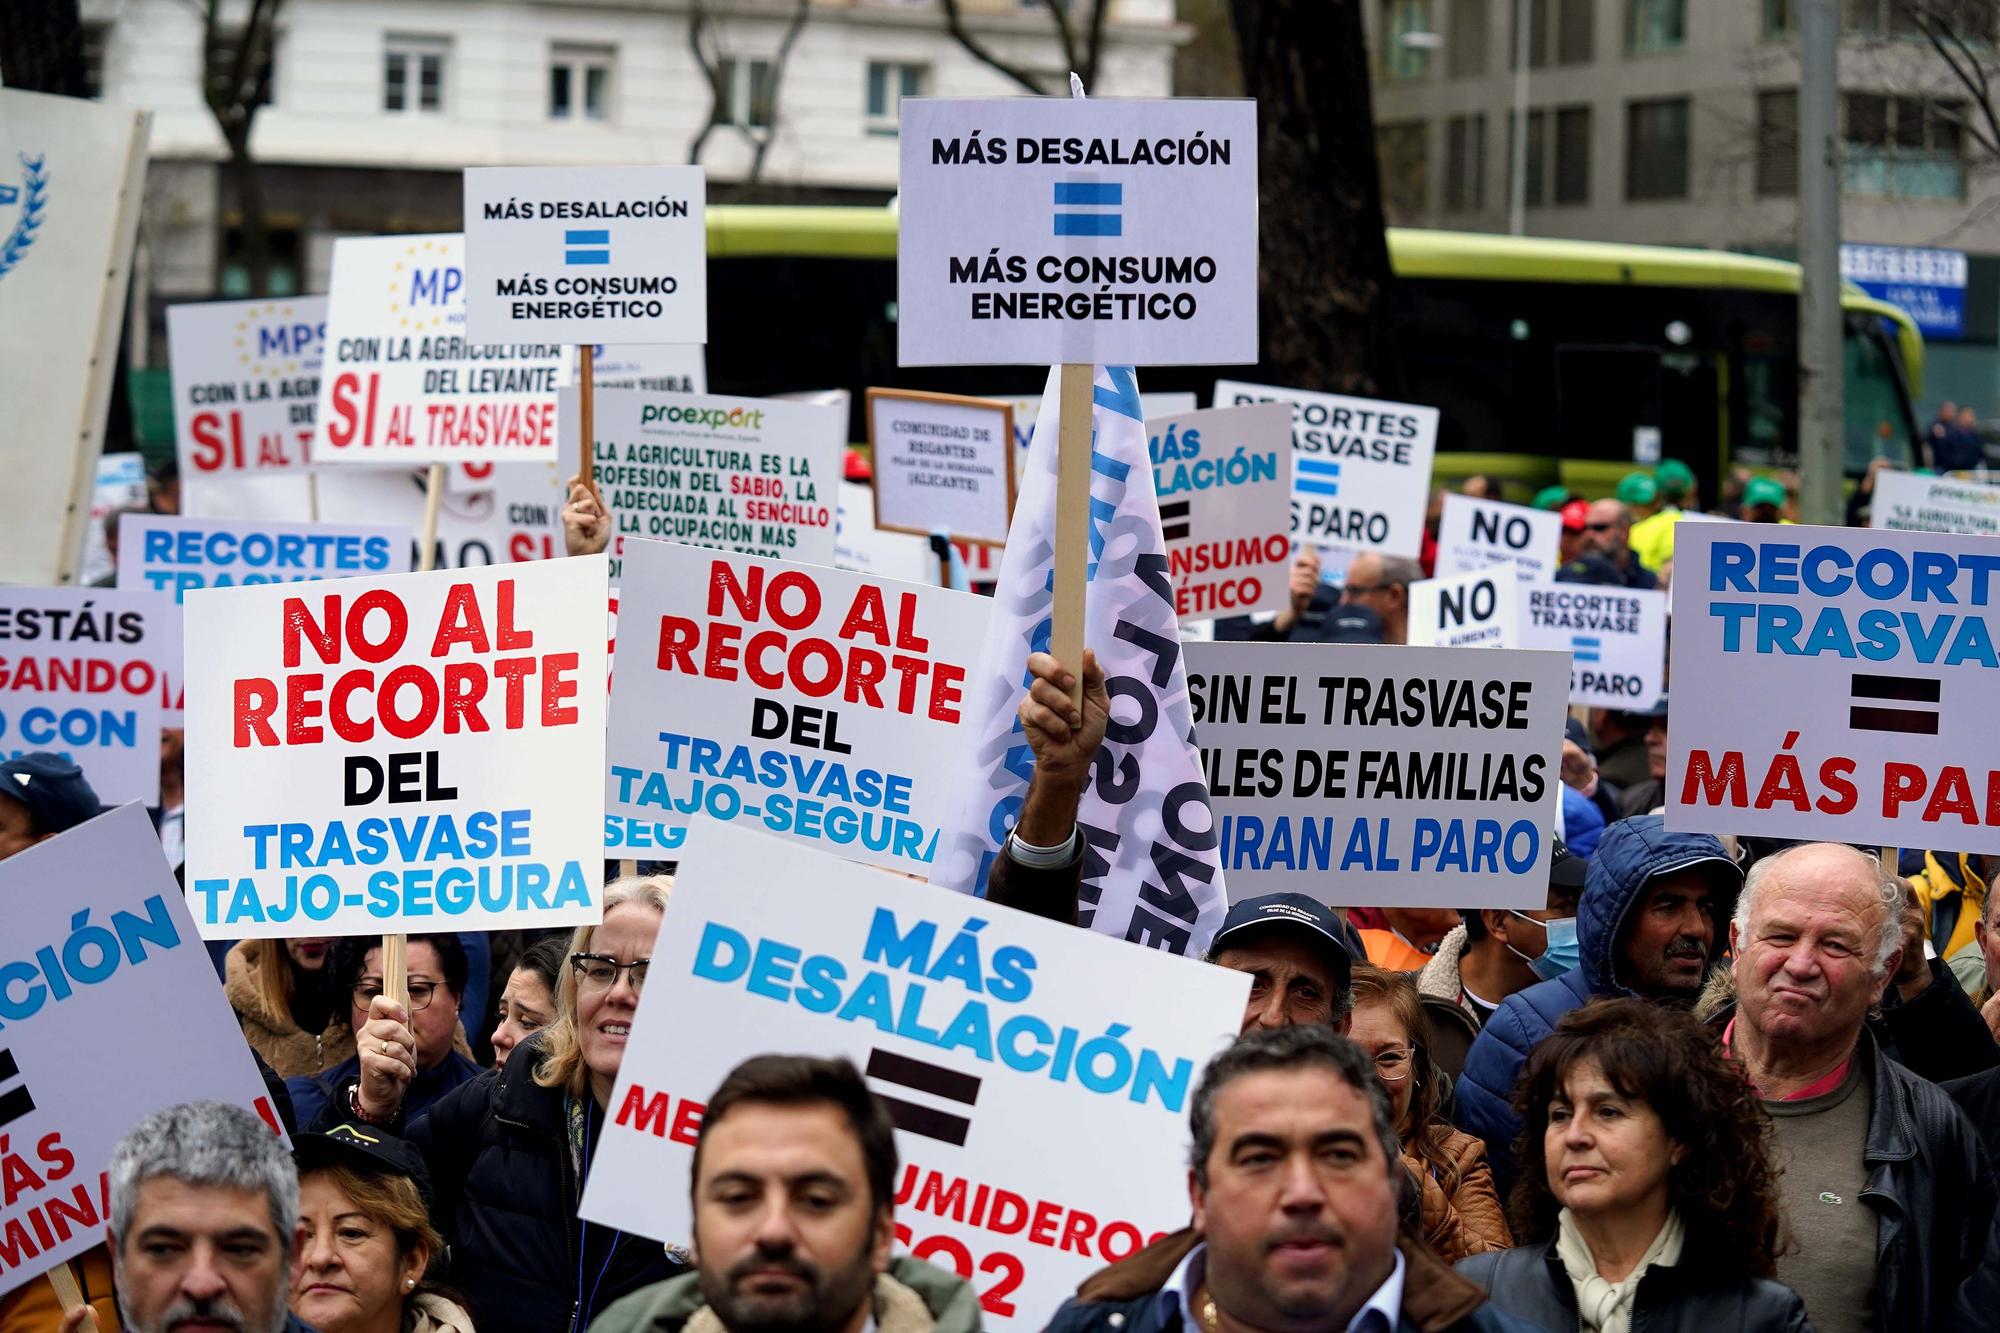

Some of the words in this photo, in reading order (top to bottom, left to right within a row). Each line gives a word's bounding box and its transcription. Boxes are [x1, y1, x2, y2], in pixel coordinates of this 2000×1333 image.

[932, 130, 1007, 165] MÁS
[1016, 131, 1231, 165] DESALACIÓN
[484, 198, 534, 220] MÁS
[541, 196, 688, 219] DESALACIÓN
[497, 273, 548, 296] MÁS
[555, 277, 677, 295] CONSUMO
[949, 248, 1027, 284] MÁS
[1036, 256, 1216, 284] CONSUMO
[512, 298, 663, 319] ENERGÉTICO
[971, 285, 1197, 320] ENERGÉTICO
[338, 337, 381, 363] CON
[387, 336, 412, 362] LA
[190, 382, 235, 405] CON
[243, 379, 271, 402] LA
[424, 369, 465, 395] DEL
[469, 367, 558, 394] LEVANTE
[327, 372, 380, 449] SI
[385, 404, 416, 447] AL
[427, 403, 556, 447] TRASVASE
[641, 404, 766, 431] proexport
[190, 410, 244, 472] SI
[256, 432, 291, 468] AL
[627, 443, 752, 472] AGRICULTURA
[761, 454, 783, 475] ES
[790, 456, 811, 478] LA
[691, 472, 722, 493] DEL
[730, 474, 788, 502] SABIO,
[797, 482, 817, 503] LA
[612, 491, 713, 516] ADECUADA
[717, 498, 738, 519] AL
[746, 502, 829, 528] SENCILLO
[1308, 503, 1390, 545] PARO
[1471, 508, 1532, 551] NO
[144, 530, 391, 570] RECORTES
[619, 514, 641, 533] LA
[650, 515, 751, 544] OCUPACIÓN
[761, 525, 798, 549] MÁS
[1168, 534, 1290, 577] NSUMO
[1709, 541, 2000, 607] RECORT
[0, 601, 144, 644] ESTÁIS
[283, 589, 408, 668] NO
[430, 578, 533, 659] AL
[707, 559, 822, 632] NO
[838, 584, 929, 655] AL
[1438, 578, 1497, 630] NO
[1530, 590, 1641, 615] RECORTES
[1531, 610, 1639, 634] TRASVASE
[1709, 602, 2000, 669] TRASVA
[656, 614, 966, 725] RECORTE
[1581, 671, 1643, 697] PARO
[233, 652, 579, 749] RECORTE
[1187, 673, 1252, 727] SIN
[1260, 675, 1306, 726] EL
[1317, 676, 1532, 730] TRASVASE
[20, 706, 137, 748] CON
[751, 697, 852, 755] DEL
[344, 750, 458, 807] DEL
[659, 730, 913, 815] TRASVASE
[1292, 749, 1349, 799] DE
[1356, 751, 1546, 803] FAMILIAS
[1680, 730, 1858, 815] MÁS
[243, 808, 532, 871] TRASVASE
[1340, 817, 1399, 872] AL
[1411, 818, 1540, 875] PARO
[195, 861, 592, 924] TAJO-SEGURA
[0, 894, 181, 1032] CIÓN
[863, 905, 1037, 1003] MÁS
[692, 921, 1193, 1112] DESALACIÓN
[894, 1163, 1168, 1263] UMIDERO
